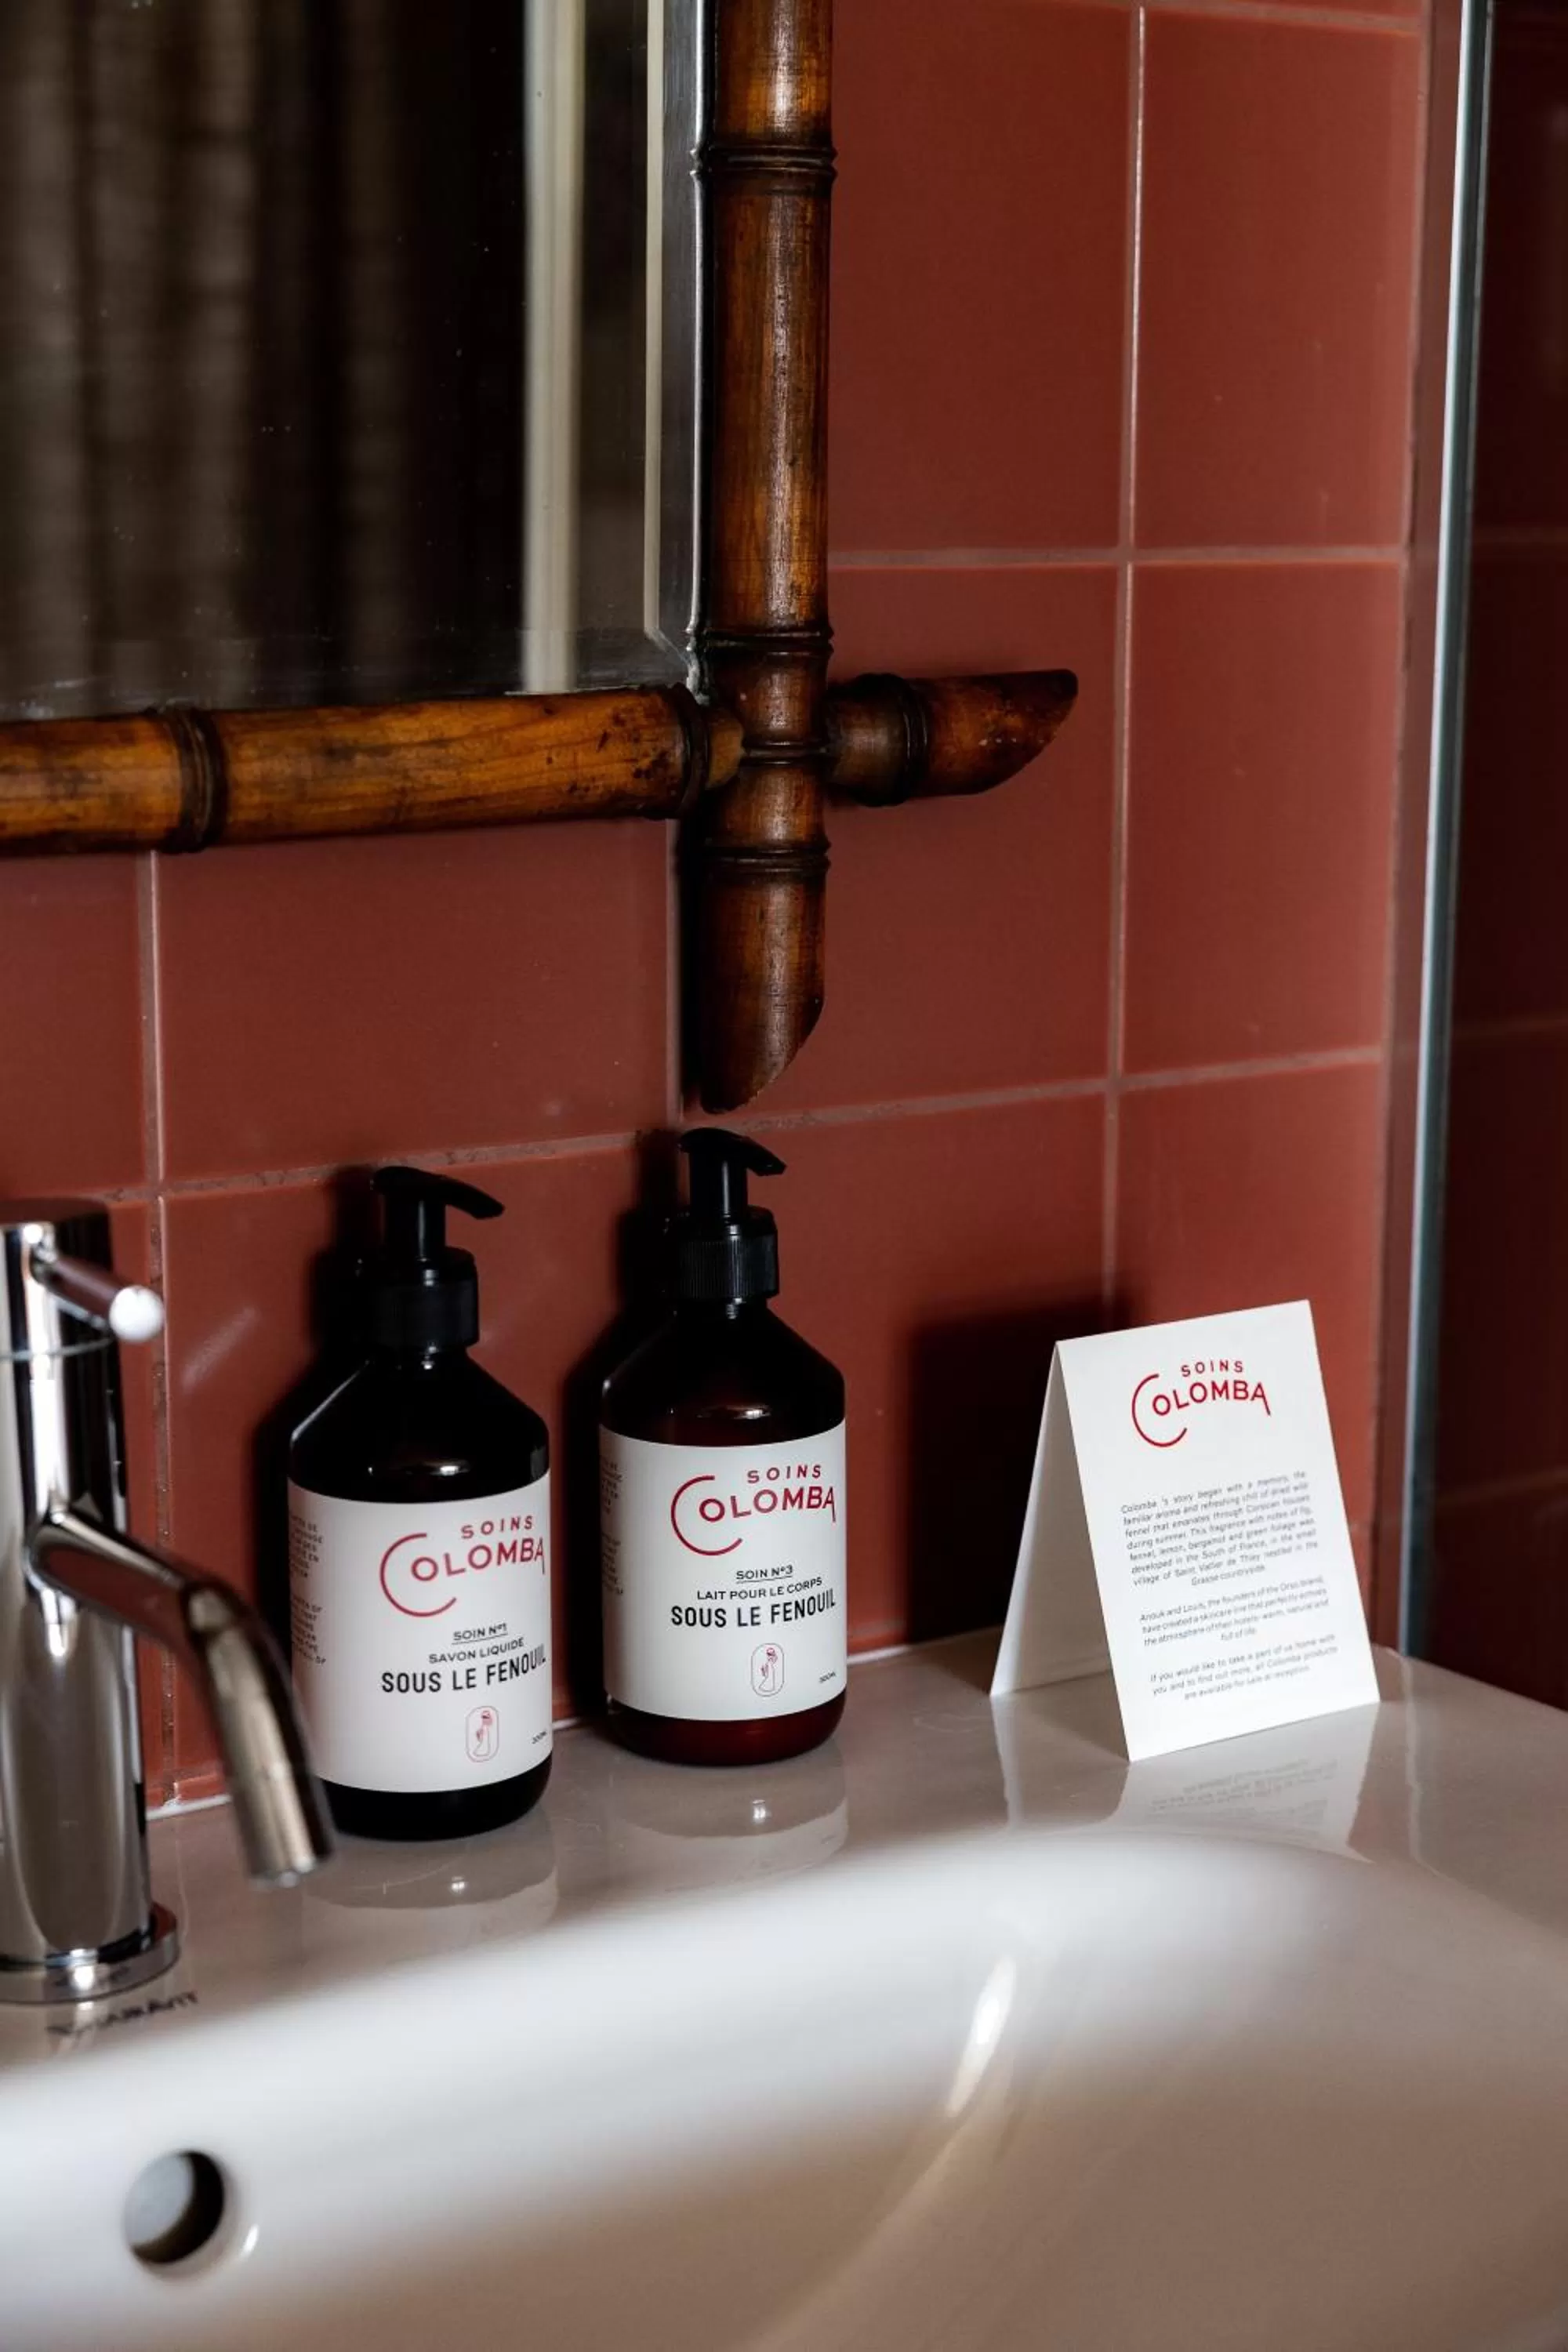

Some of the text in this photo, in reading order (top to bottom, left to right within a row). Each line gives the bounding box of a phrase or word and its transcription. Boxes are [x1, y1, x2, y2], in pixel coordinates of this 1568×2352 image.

[1181, 1360, 1243, 1377] SOINS
[1131, 1374, 1271, 1448] COLOMBA
[747, 1465, 822, 1484] SOINS
[670, 1474, 837, 1556] COLOMBA
[1120, 1499, 1156, 1514] Colomba
[461, 1515, 534, 1539] SOINS
[1124, 1523, 1150, 1538] fennel
[379, 1533, 546, 1619] COLOMBA
[736, 1570, 768, 1581] SOIN
[697, 1576, 823, 1600] LAIT POUR LE CORPS
[671, 1588, 836, 1628] SOUS LE FENOUIL
[453, 1628, 485, 1641] SOIN
[429, 1637, 524, 1664] SAVON LIQUIDE
[382, 1644, 546, 1693] SOUS LE FENOUIL
